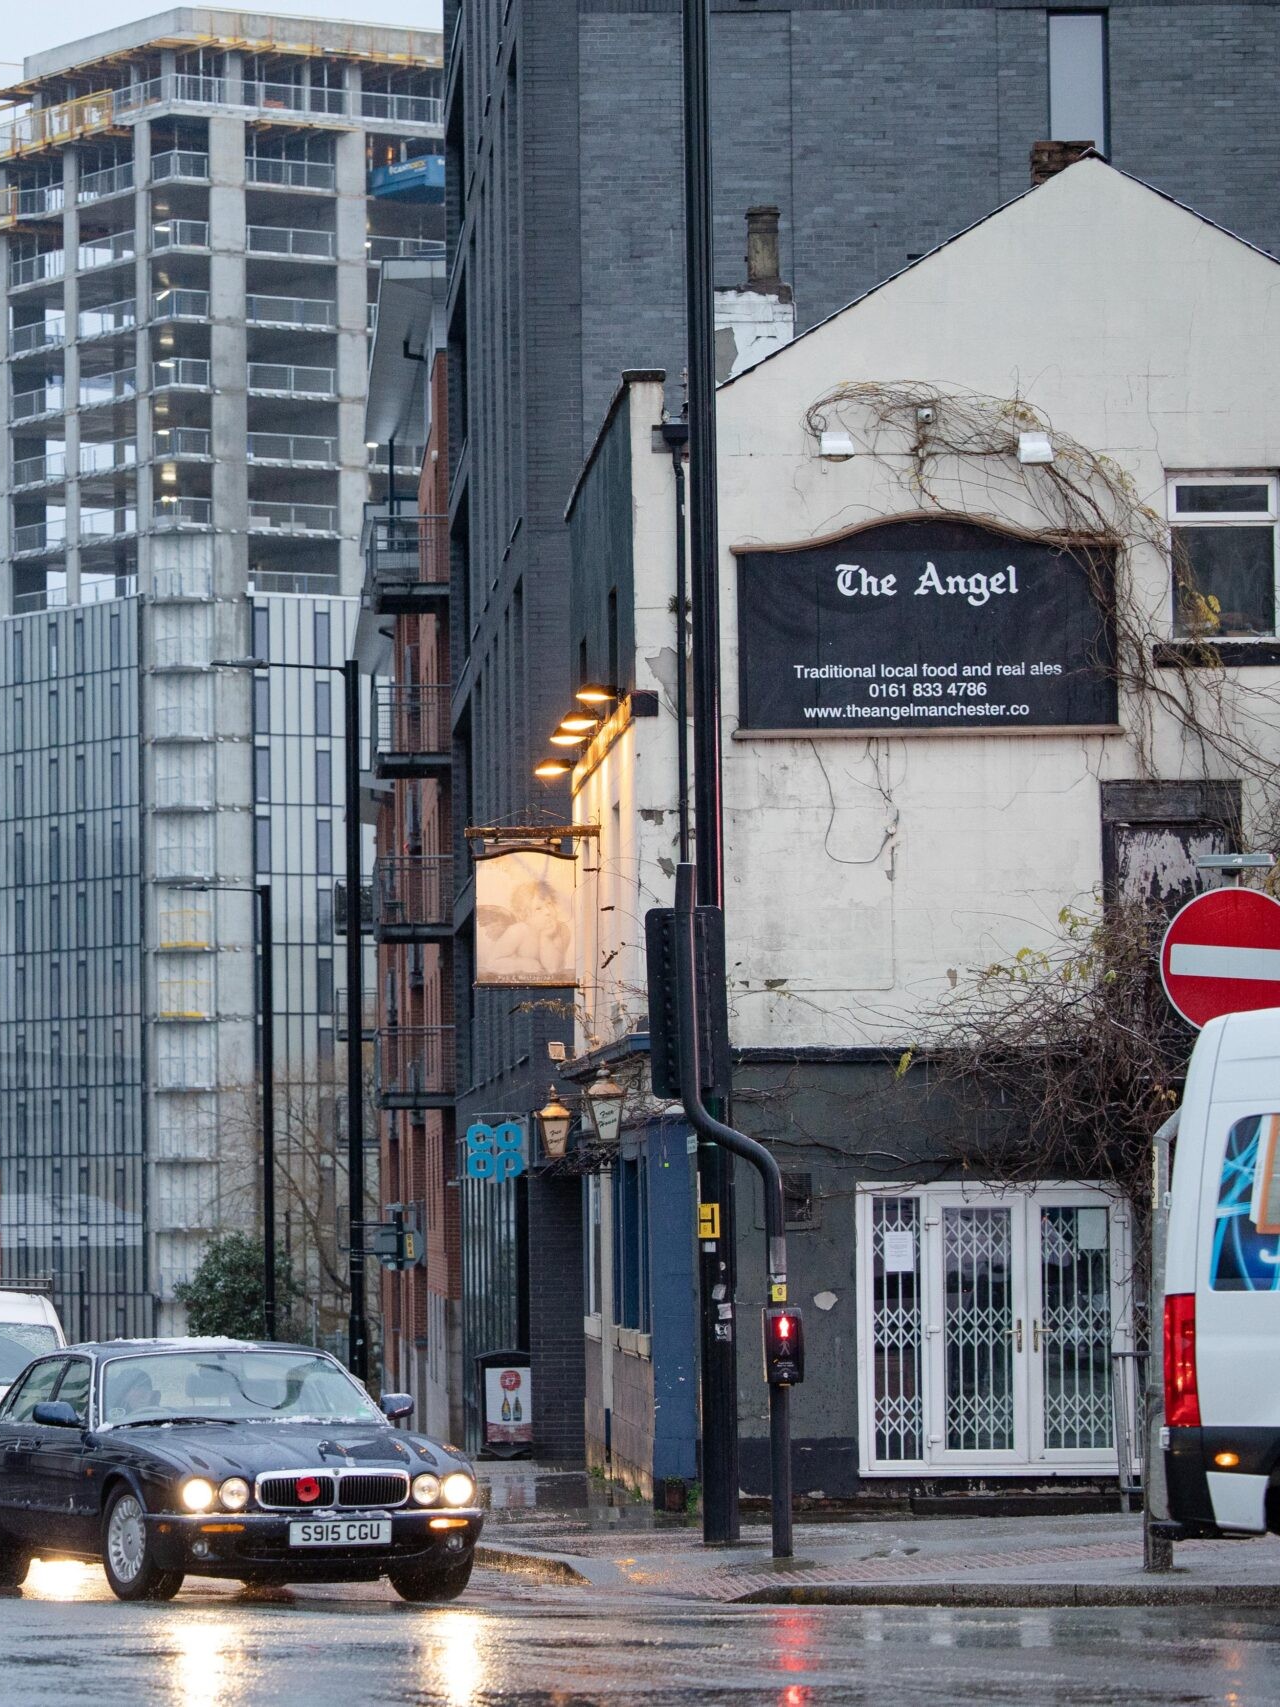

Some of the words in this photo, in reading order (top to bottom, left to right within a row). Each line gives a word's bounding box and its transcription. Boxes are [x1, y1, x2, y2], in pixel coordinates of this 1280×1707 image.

[835, 563, 898, 597] The
[914, 561, 1019, 607] Angel
[793, 663, 876, 679] Traditional
[880, 663, 918, 678] local
[922, 662, 958, 677] food
[962, 662, 991, 677] and
[996, 661, 1026, 676] real
[1030, 661, 1063, 676] ales
[868, 683, 906, 698] 0161
[912, 682, 943, 697] 833
[946, 681, 988, 697] 4786
[803, 702, 1030, 720] www.theangelmanchester.co
[301, 1525, 341, 1541] S915
[346, 1523, 380, 1540] CGU
